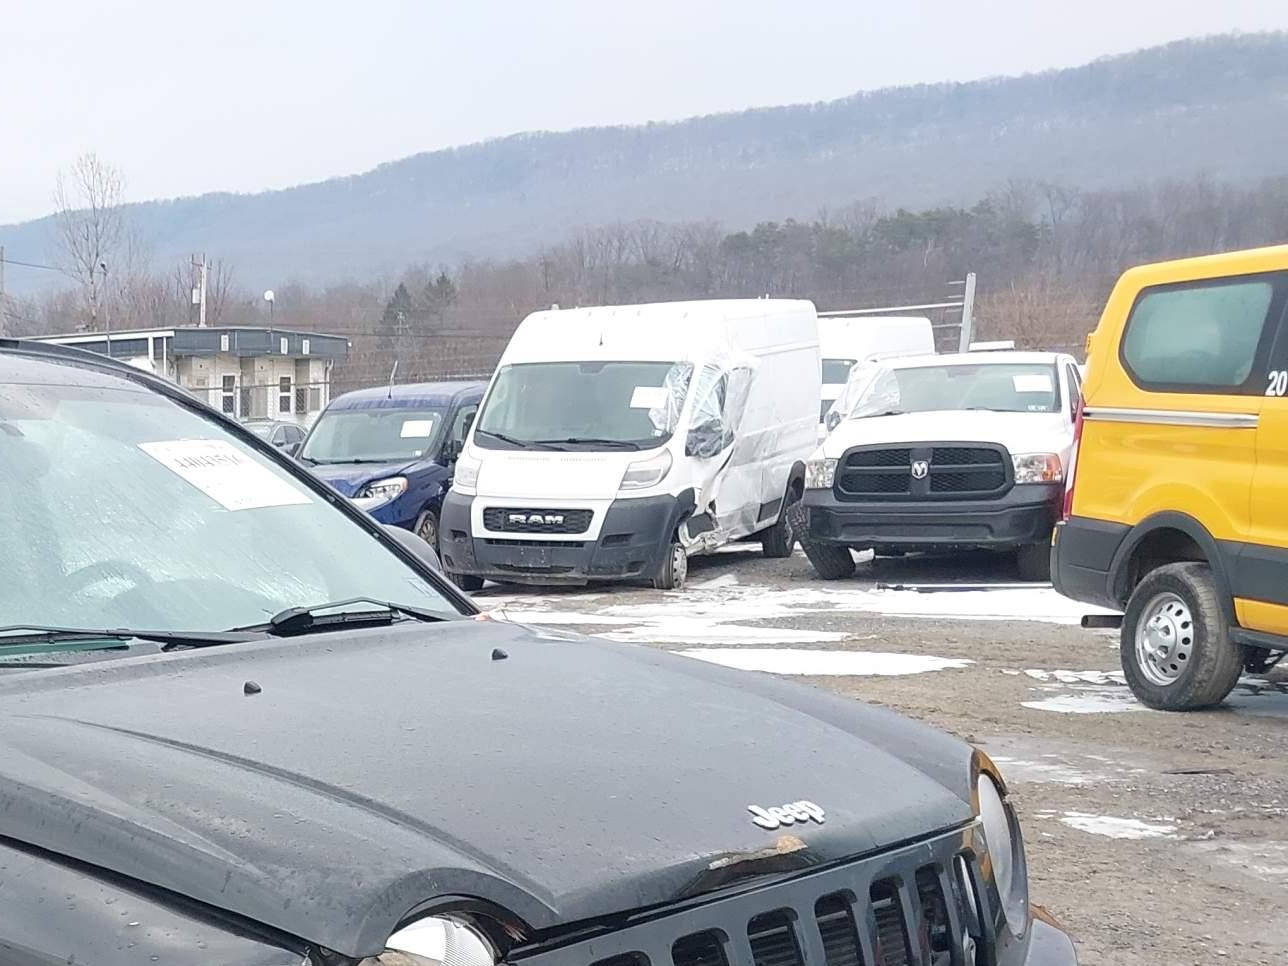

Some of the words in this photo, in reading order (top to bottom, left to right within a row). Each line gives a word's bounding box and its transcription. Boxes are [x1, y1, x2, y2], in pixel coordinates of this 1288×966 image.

[1264, 370, 1288, 397] 20
[508, 514, 564, 525] RAM
[746, 800, 825, 829] Jeep
